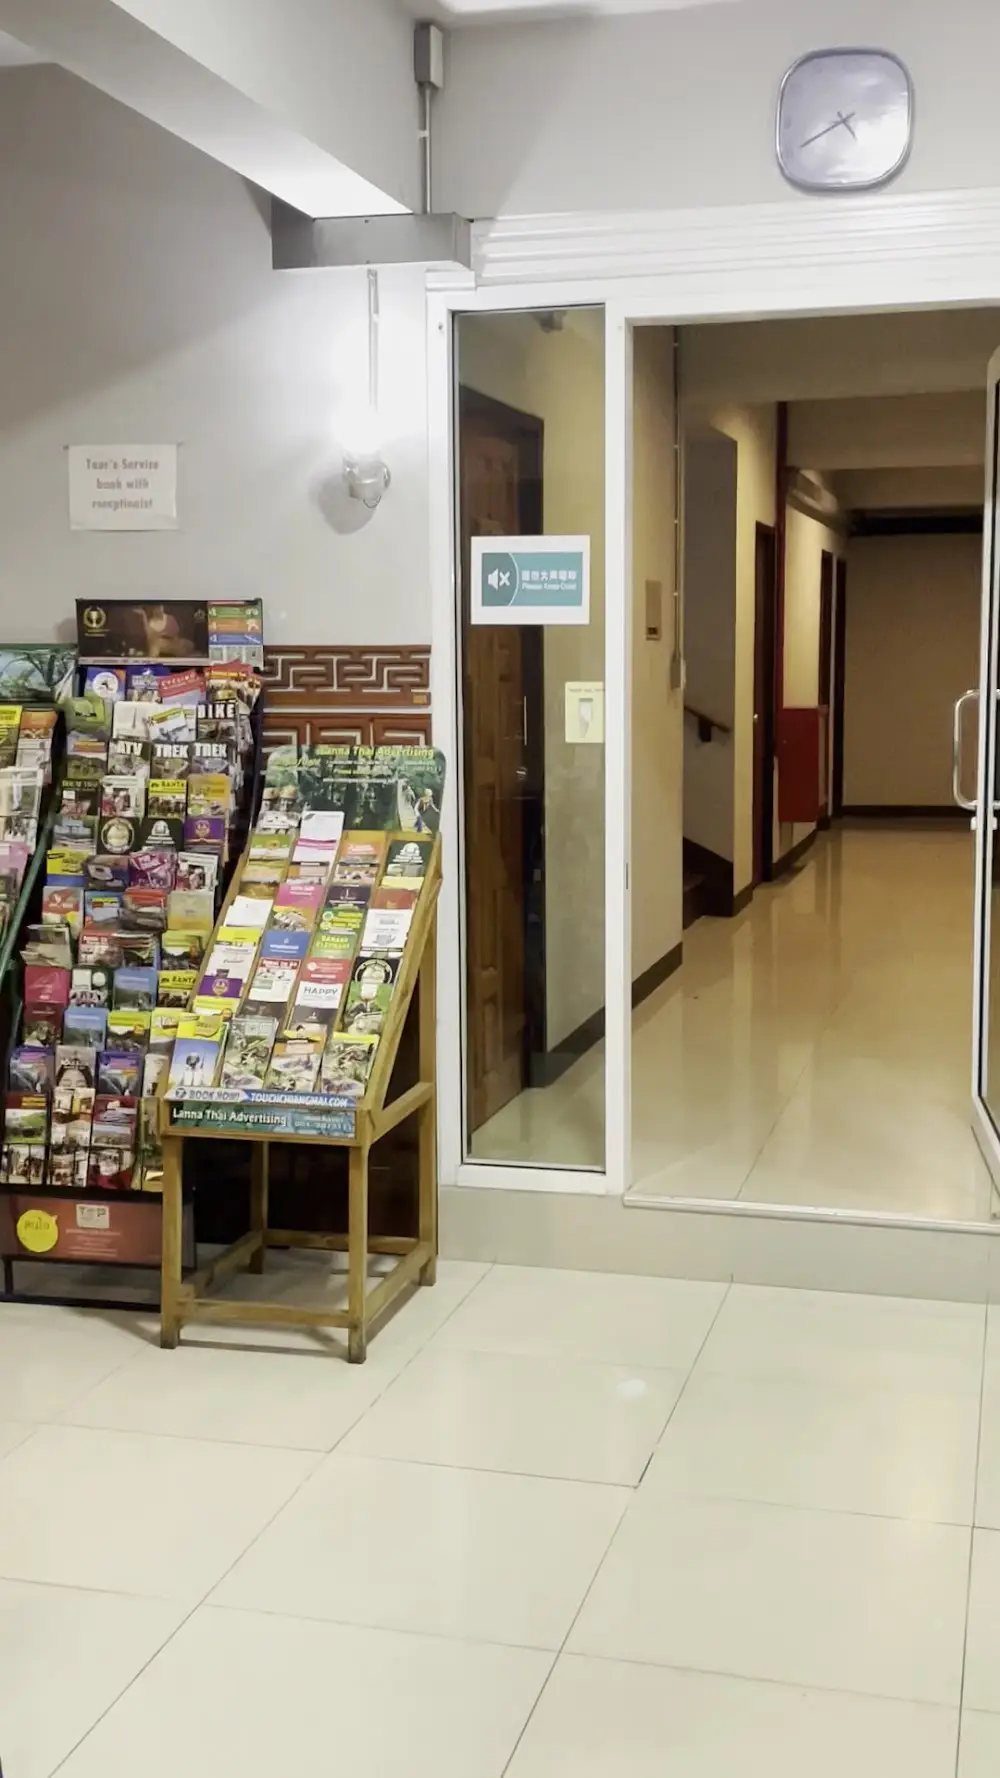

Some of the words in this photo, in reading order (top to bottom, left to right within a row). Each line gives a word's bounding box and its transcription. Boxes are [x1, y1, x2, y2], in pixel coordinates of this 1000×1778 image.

[122, 458, 160, 470] Service
[96, 478, 122, 490] book
[126, 478, 149, 489] with
[198, 704, 236, 718] BIKE
[118, 741, 143, 756] ATV
[155, 744, 189, 758] TREK
[194, 743, 228, 757] TREK
[376, 747, 434, 759] Advertising
[304, 986, 338, 995] HAPPY
[173, 1108, 203, 1119] Lanna
[206, 1109, 227, 1121] Thai
[229, 1111, 287, 1126] Advertising
